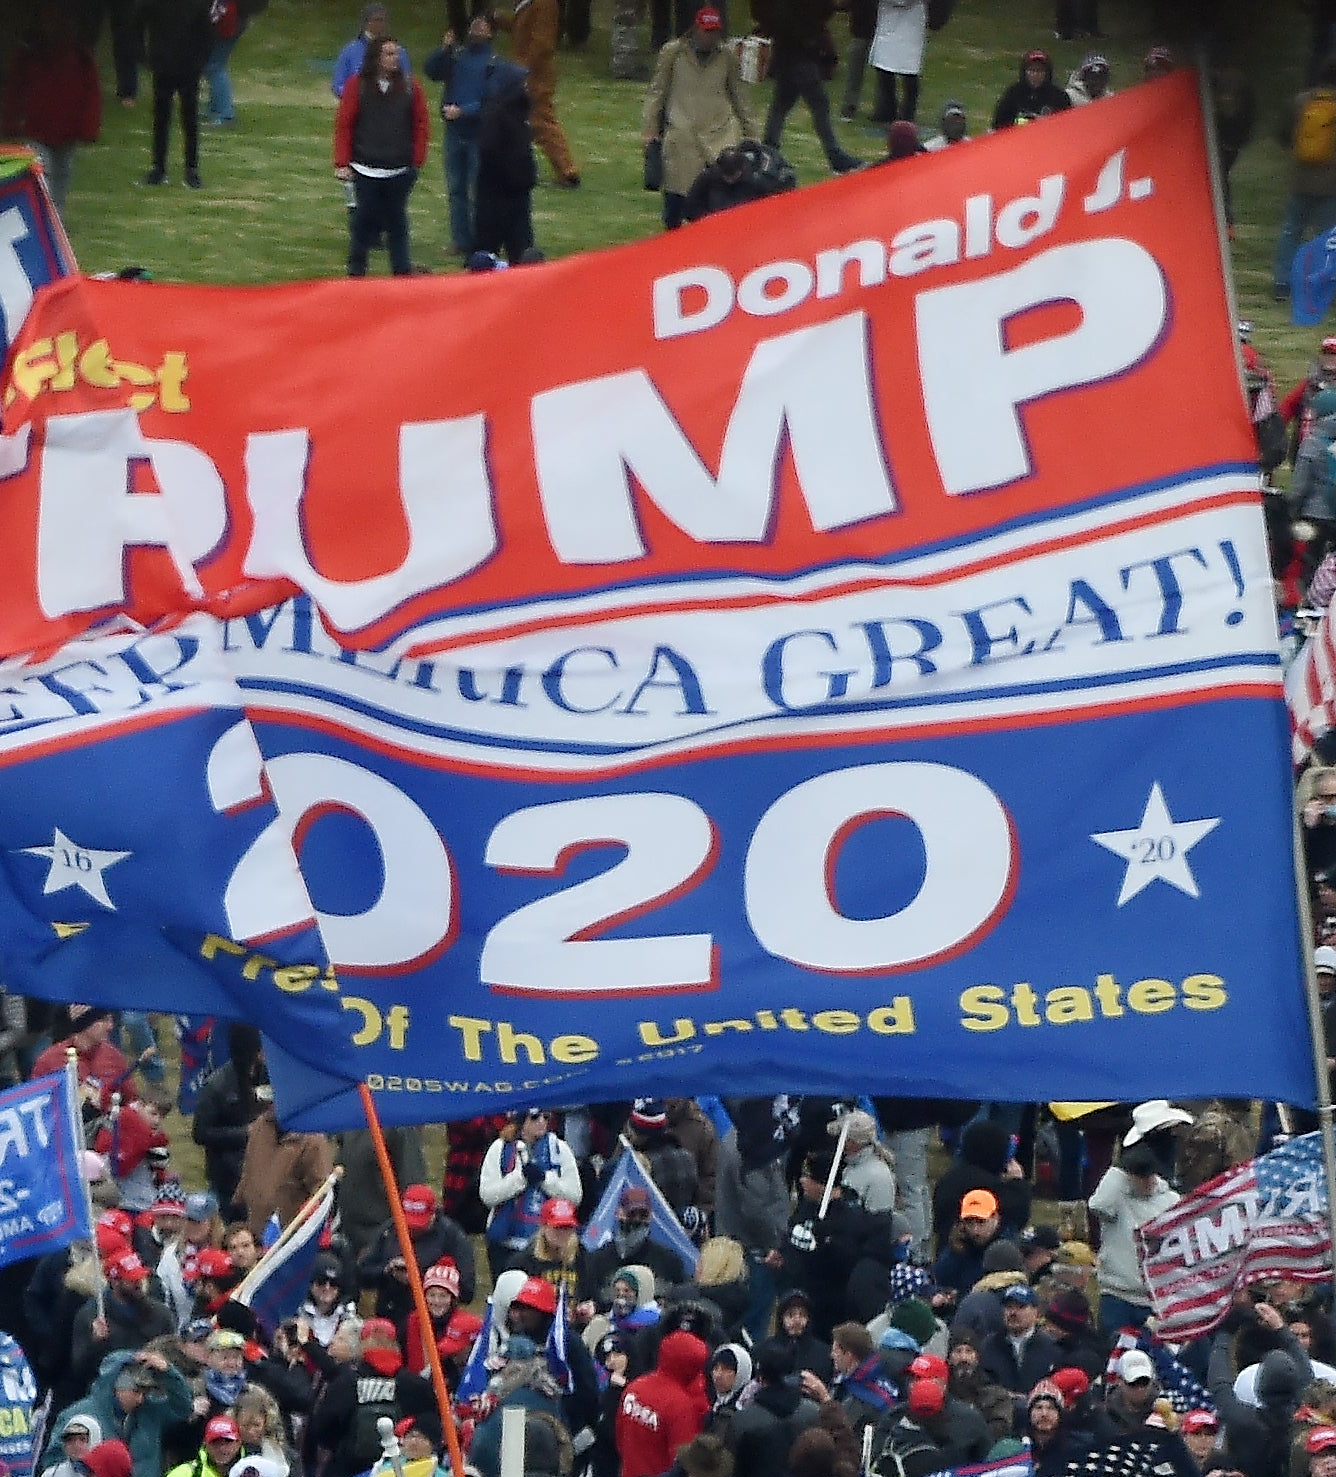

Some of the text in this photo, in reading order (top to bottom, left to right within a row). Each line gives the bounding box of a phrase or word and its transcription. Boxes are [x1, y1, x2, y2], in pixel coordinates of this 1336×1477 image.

[653, 149, 1154, 339] Donald J.
[761, 539, 1245, 712] GREAT!
[449, 1015, 600, 1065] The
[639, 996, 916, 1046] United
[959, 973, 1228, 1031] States
